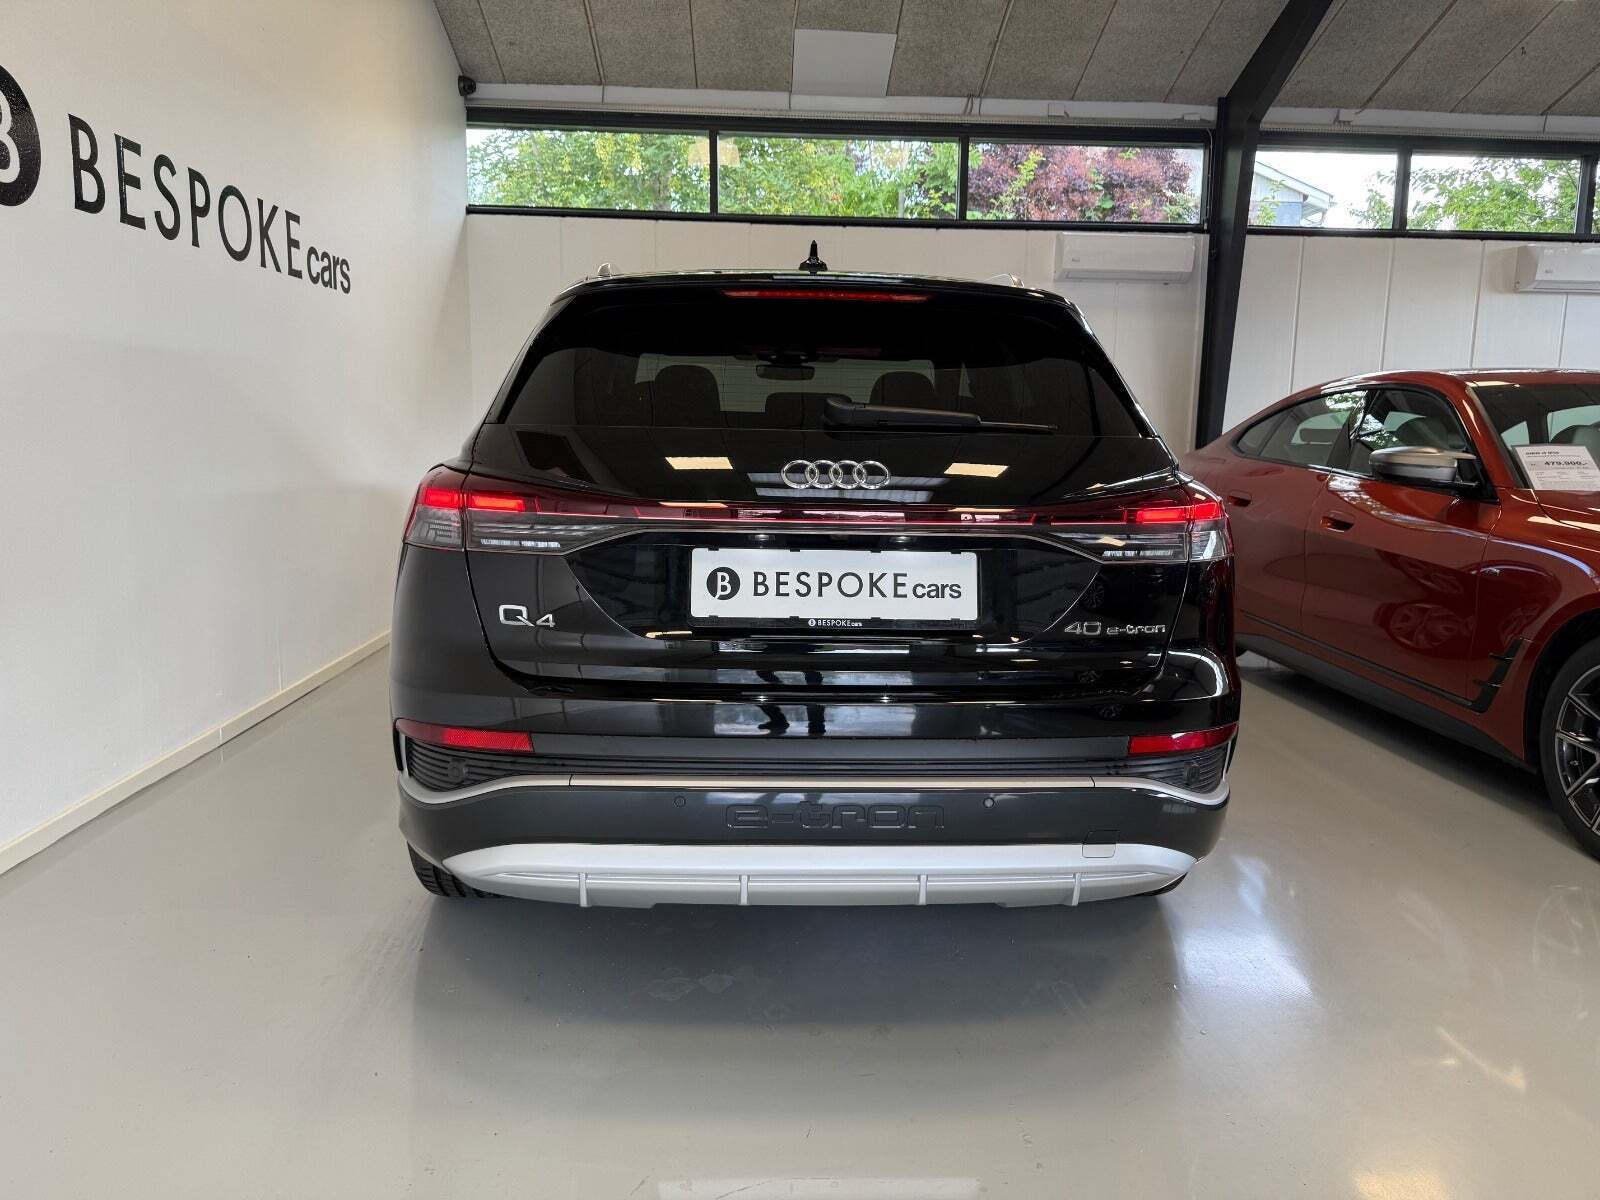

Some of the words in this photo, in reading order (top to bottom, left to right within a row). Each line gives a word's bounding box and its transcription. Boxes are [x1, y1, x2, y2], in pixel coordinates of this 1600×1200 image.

[68, 113, 303, 279] BESPOKE
[306, 245, 351, 294] cars
[753, 571, 907, 597] BESPOKE
[912, 580, 962, 599] cars
[1064, 621, 1101, 635] 40
[1106, 624, 1166, 635] e-tron
[725, 800, 944, 829] e-tron
